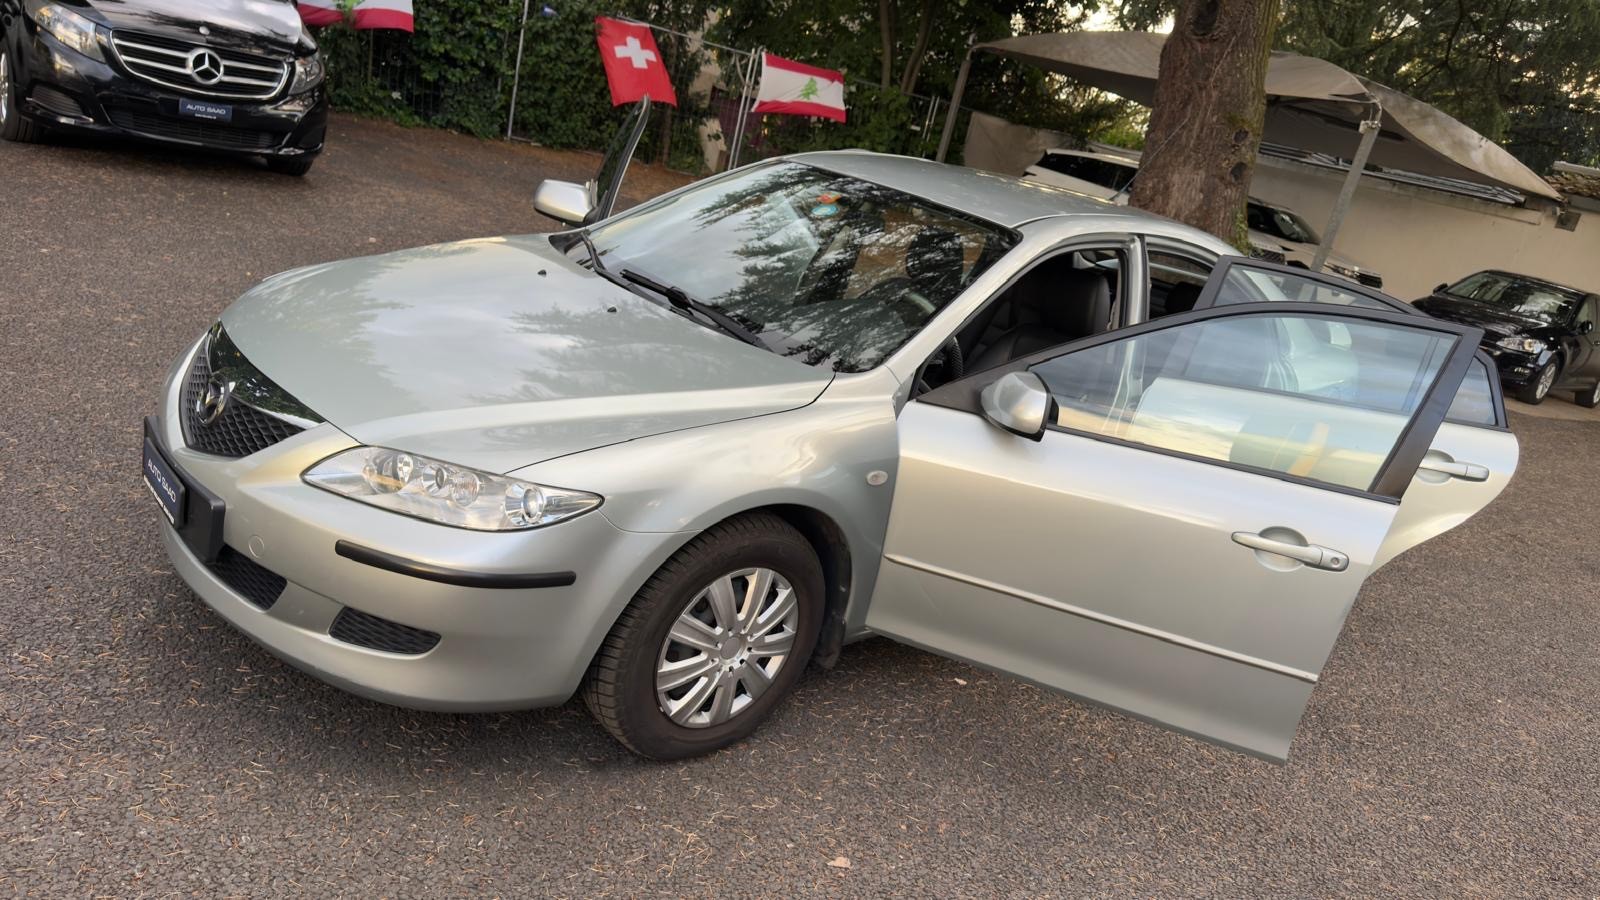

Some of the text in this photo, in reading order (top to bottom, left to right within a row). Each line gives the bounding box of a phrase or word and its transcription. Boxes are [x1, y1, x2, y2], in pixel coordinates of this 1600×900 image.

[186, 104, 205, 112] AUTO
[147, 458, 161, 483] AUTO
[161, 477, 176, 503] SAAD
